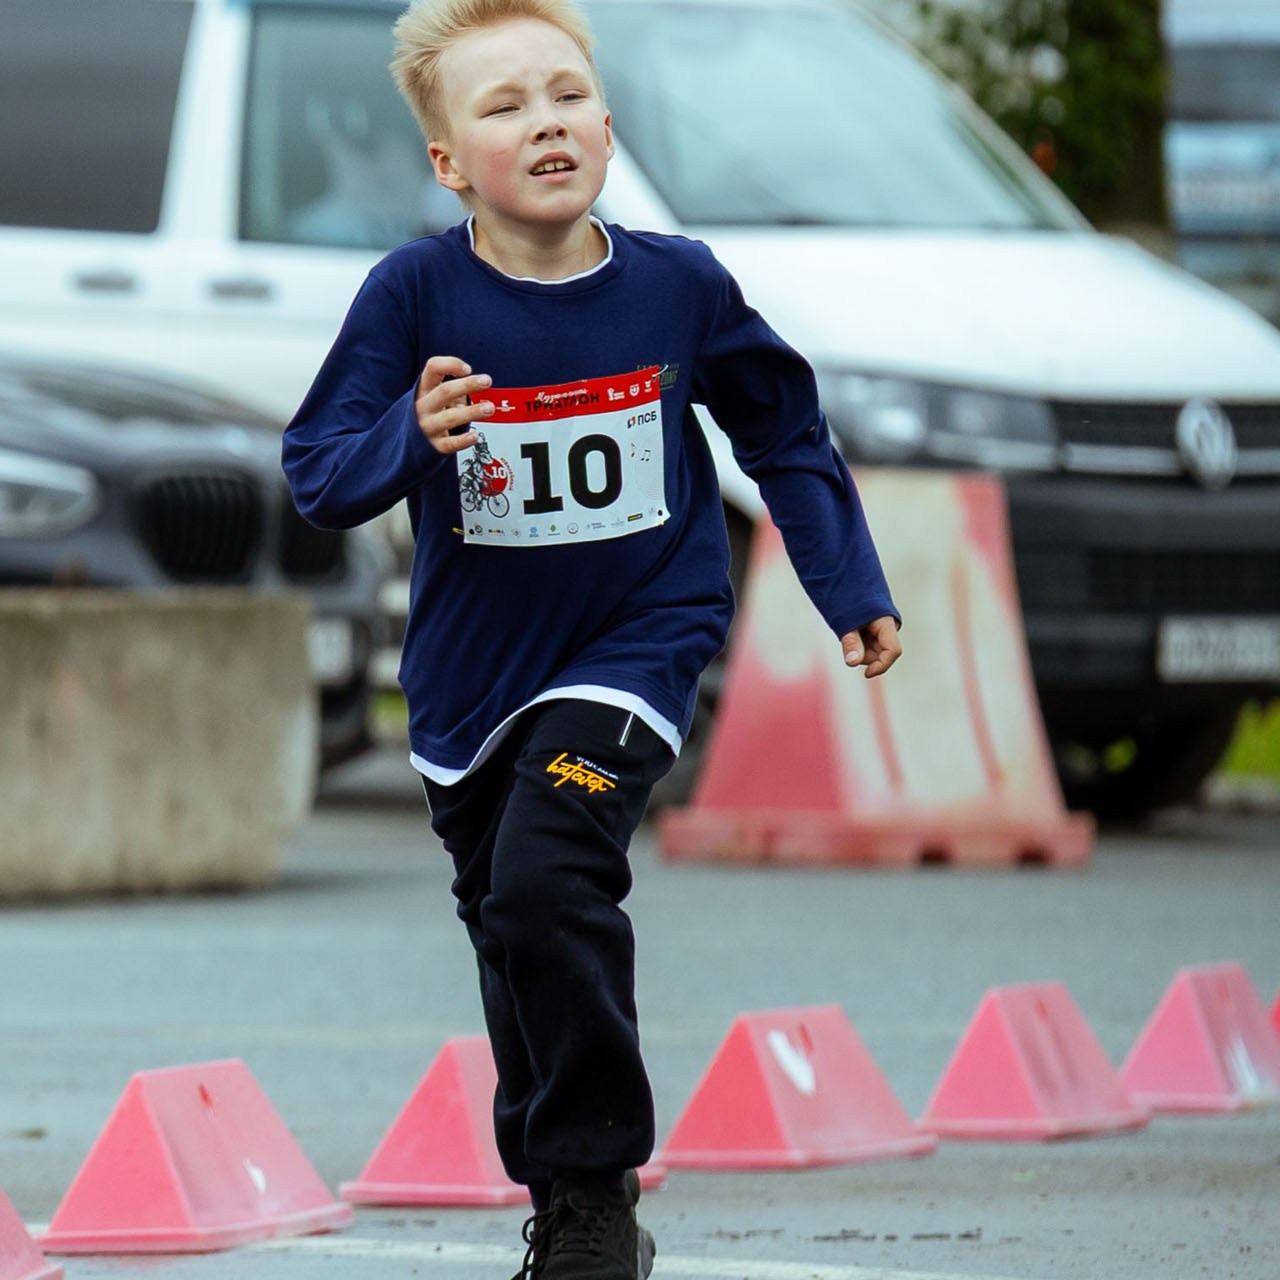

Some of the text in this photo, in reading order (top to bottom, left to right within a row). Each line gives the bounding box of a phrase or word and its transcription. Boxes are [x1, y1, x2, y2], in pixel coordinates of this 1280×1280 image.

[525, 392, 600, 413] ТРИАТЛОН
[637, 410, 657, 426] ПСБ
[491, 466, 507, 479] 10
[520, 434, 622, 515] 10
